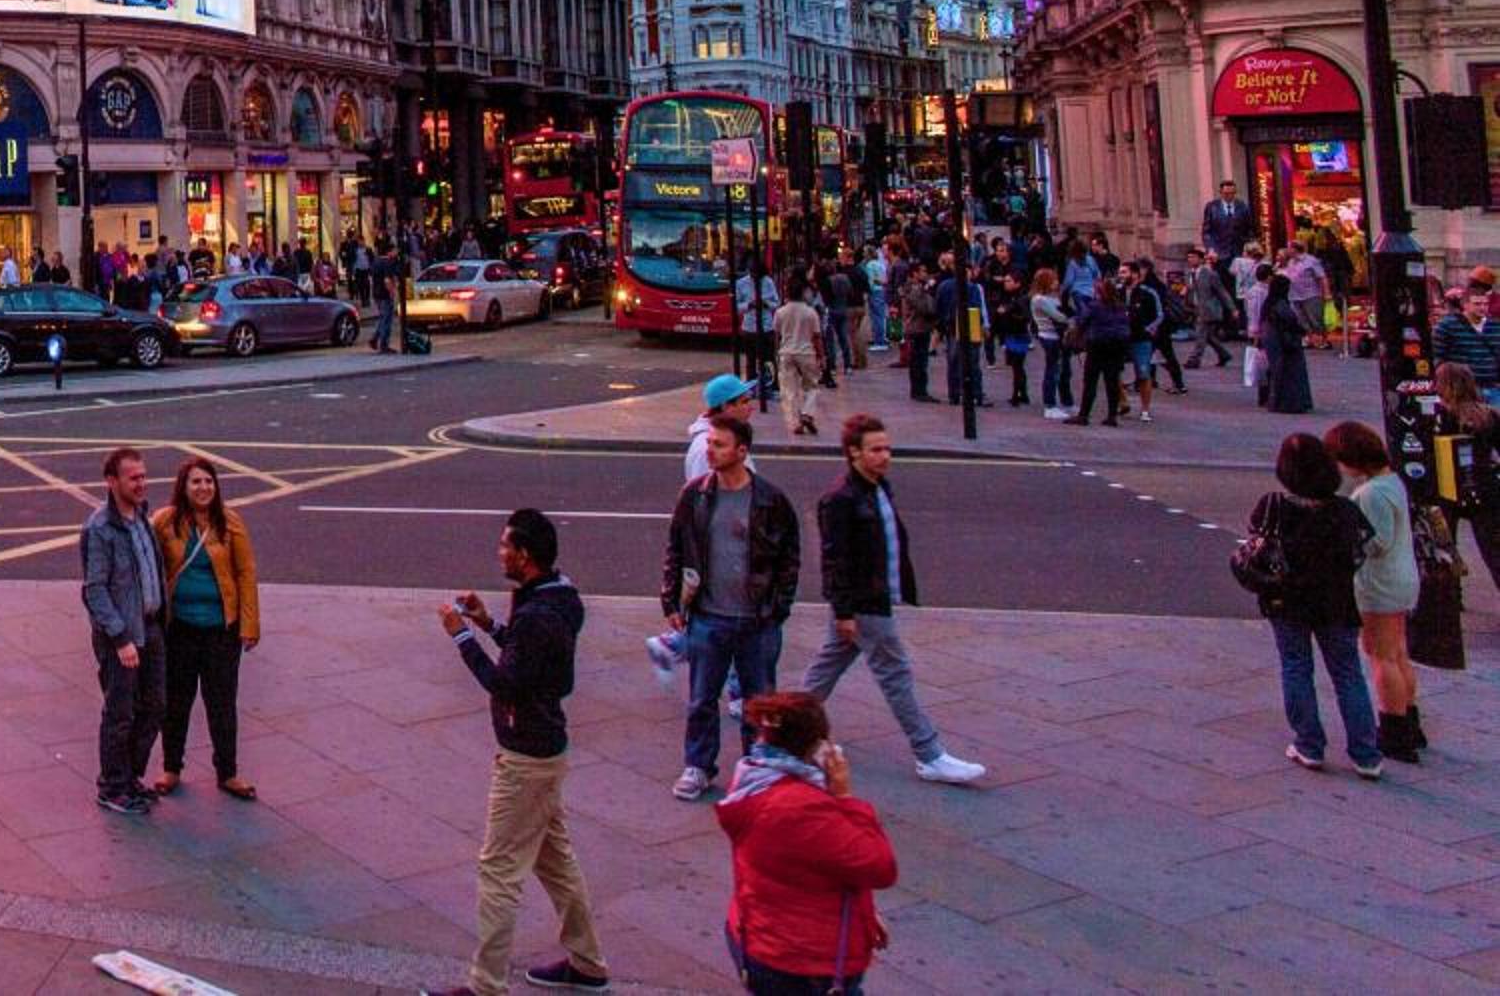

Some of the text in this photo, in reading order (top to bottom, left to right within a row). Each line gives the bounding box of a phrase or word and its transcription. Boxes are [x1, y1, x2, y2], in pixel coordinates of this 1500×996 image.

[1235, 69, 1319, 89] Believe It
[107, 90, 131, 110] GAP
[1245, 87, 1307, 105] or Not!
[655, 183, 701, 196] Victoria
